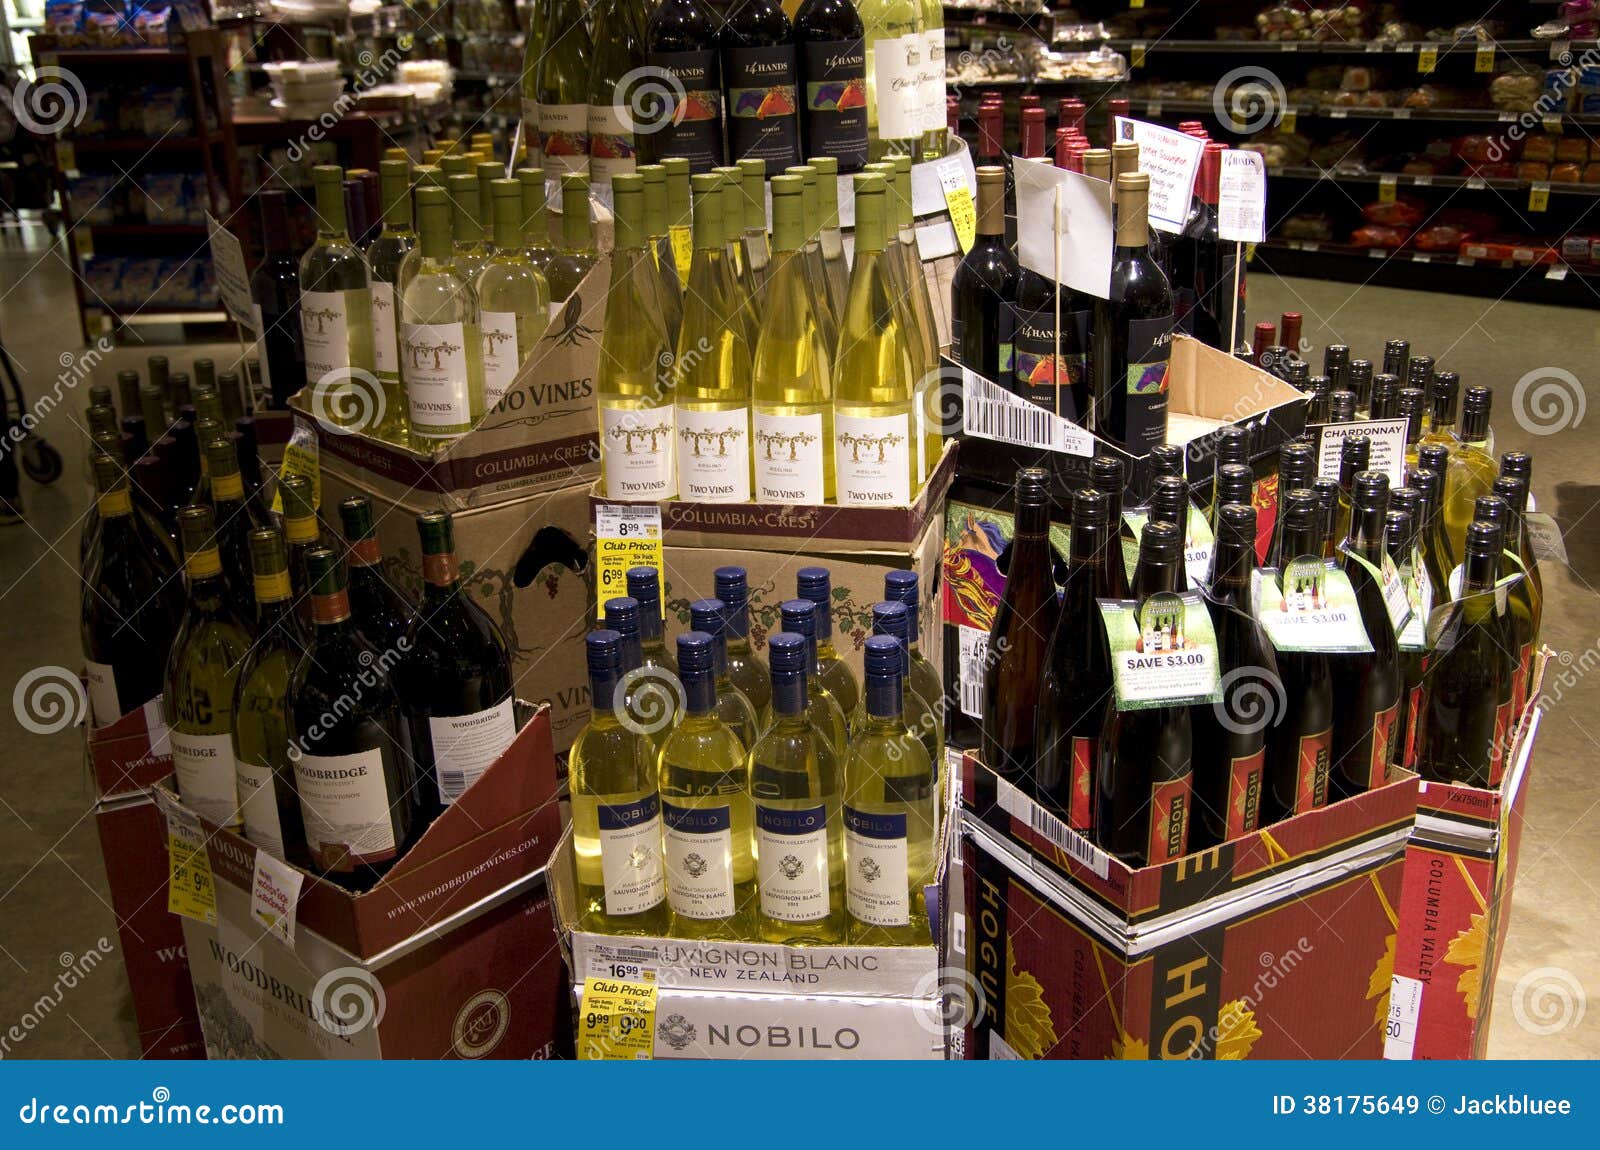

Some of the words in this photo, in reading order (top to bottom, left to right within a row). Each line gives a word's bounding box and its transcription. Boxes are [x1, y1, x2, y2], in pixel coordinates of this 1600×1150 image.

[757, 62, 788, 72] HANDS
[838, 56, 864, 66] HANDS
[672, 67, 705, 77] HANDS
[1032, 328, 1067, 338] HANS
[490, 390, 525, 415] WO
[529, 377, 593, 408] VINES
[412, 402, 427, 411] TWO
[428, 402, 452, 411] VINES
[1324, 426, 1402, 438] CHARDONNAY
[621, 481, 641, 491] TWO
[641, 480, 666, 490] VINES
[689, 484, 708, 494] TWO
[708, 485, 734, 494] VINES
[762, 487, 779, 498] TWO
[780, 488, 805, 499] VINES
[848, 490, 867, 501] TWO
[867, 491, 893, 501] VINES
[603, 541, 627, 551] Club
[628, 541, 657, 551] Price!
[1311, 612, 1347, 624] $3.00
[1127, 657, 1163, 670] SAVE
[1167, 653, 1204, 667] $3.00
[451, 711, 502, 730] WOODBRIDGE
[300, 765, 368, 780] OODBRIDGE
[1313, 748, 1327, 808] HOGUE
[1244, 771, 1258, 830] HOGUE
[611, 801, 657, 823] NOBILO
[667, 811, 718, 826] NOBILO
[763, 815, 816, 828] NOBILO
[1169, 795, 1184, 858] HOGUE
[387, 835, 540, 920] WWW.WOODBRIDGEWINES.COM
[706, 891, 727, 899] BLANC
[802, 892, 822, 901] BLANC
[1424, 859, 1445, 931] COLUMBIA
[616, 905, 635, 913] NEW
[691, 909, 726, 917] ZEALAND
[786, 910, 822, 919] ZEALAND
[979, 877, 1000, 1024] HOGUE
[790, 954, 879, 972] BLANC
[1418, 935, 1436, 985] VALLEY
[690, 967, 728, 980] NEW
[736, 970, 820, 985] ZEALAND
[207, 937, 354, 1047] WOODBRIDGE
[593, 981, 618, 993] Club
[620, 985, 653, 998] Price!
[708, 1024, 861, 1051] NOBILO
